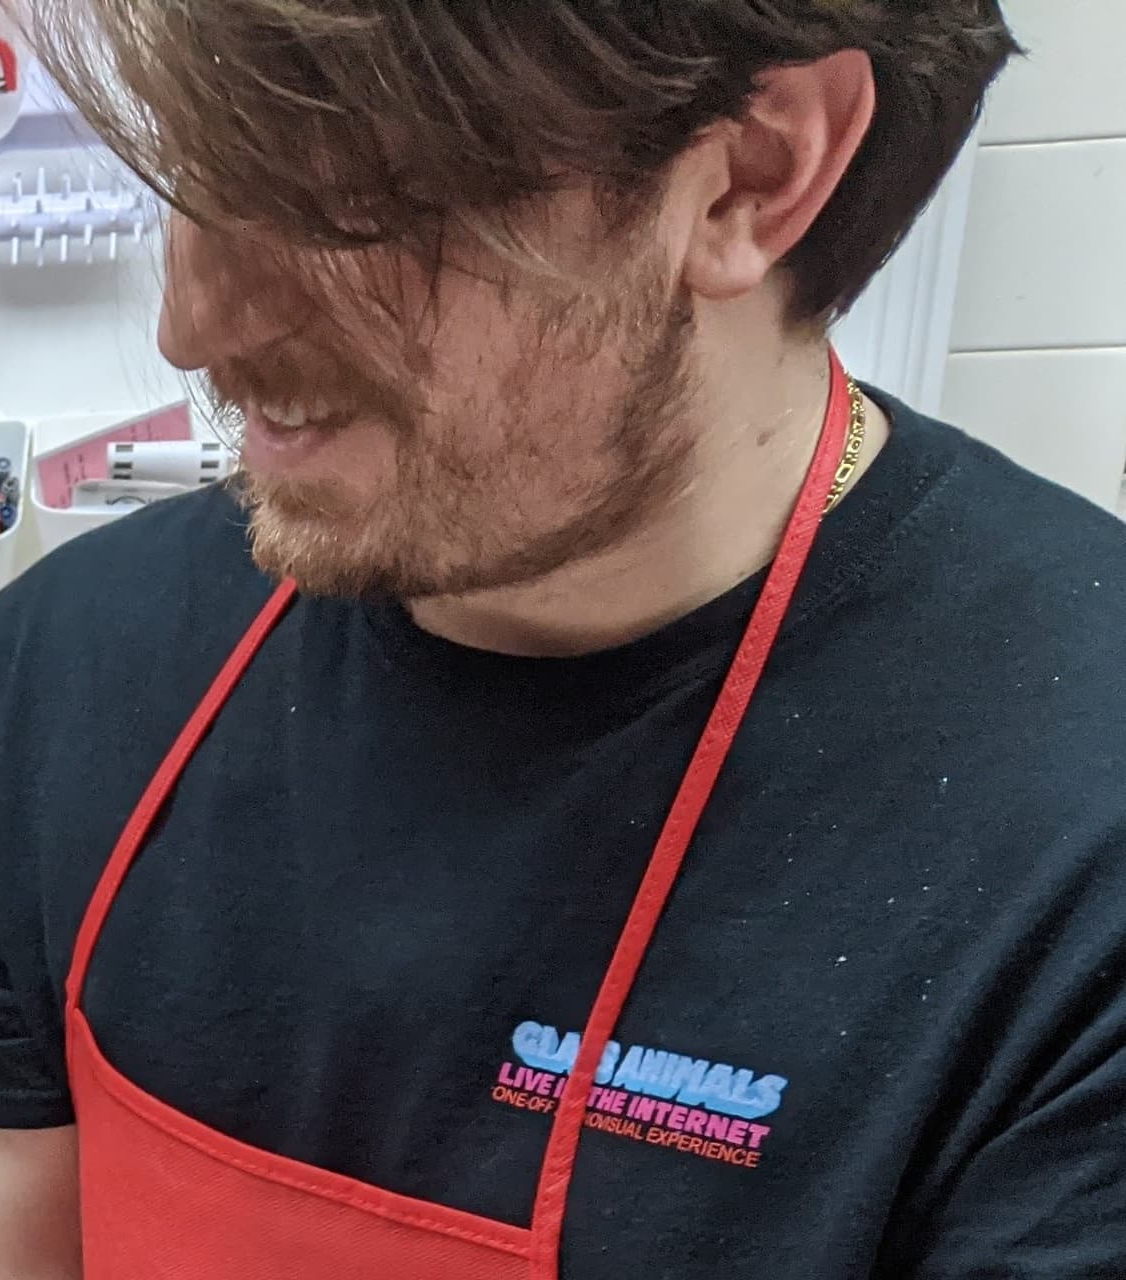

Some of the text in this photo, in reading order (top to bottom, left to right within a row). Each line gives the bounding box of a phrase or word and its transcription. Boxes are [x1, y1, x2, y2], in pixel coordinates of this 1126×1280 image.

[492, 1085, 555, 1113] ONE-OFF
[645, 1126, 763, 1168] EXPERIENCE
[498, 1061, 557, 1096] LIVE
[587, 1086, 629, 1115] THE
[626, 1095, 771, 1148] INTERNET
